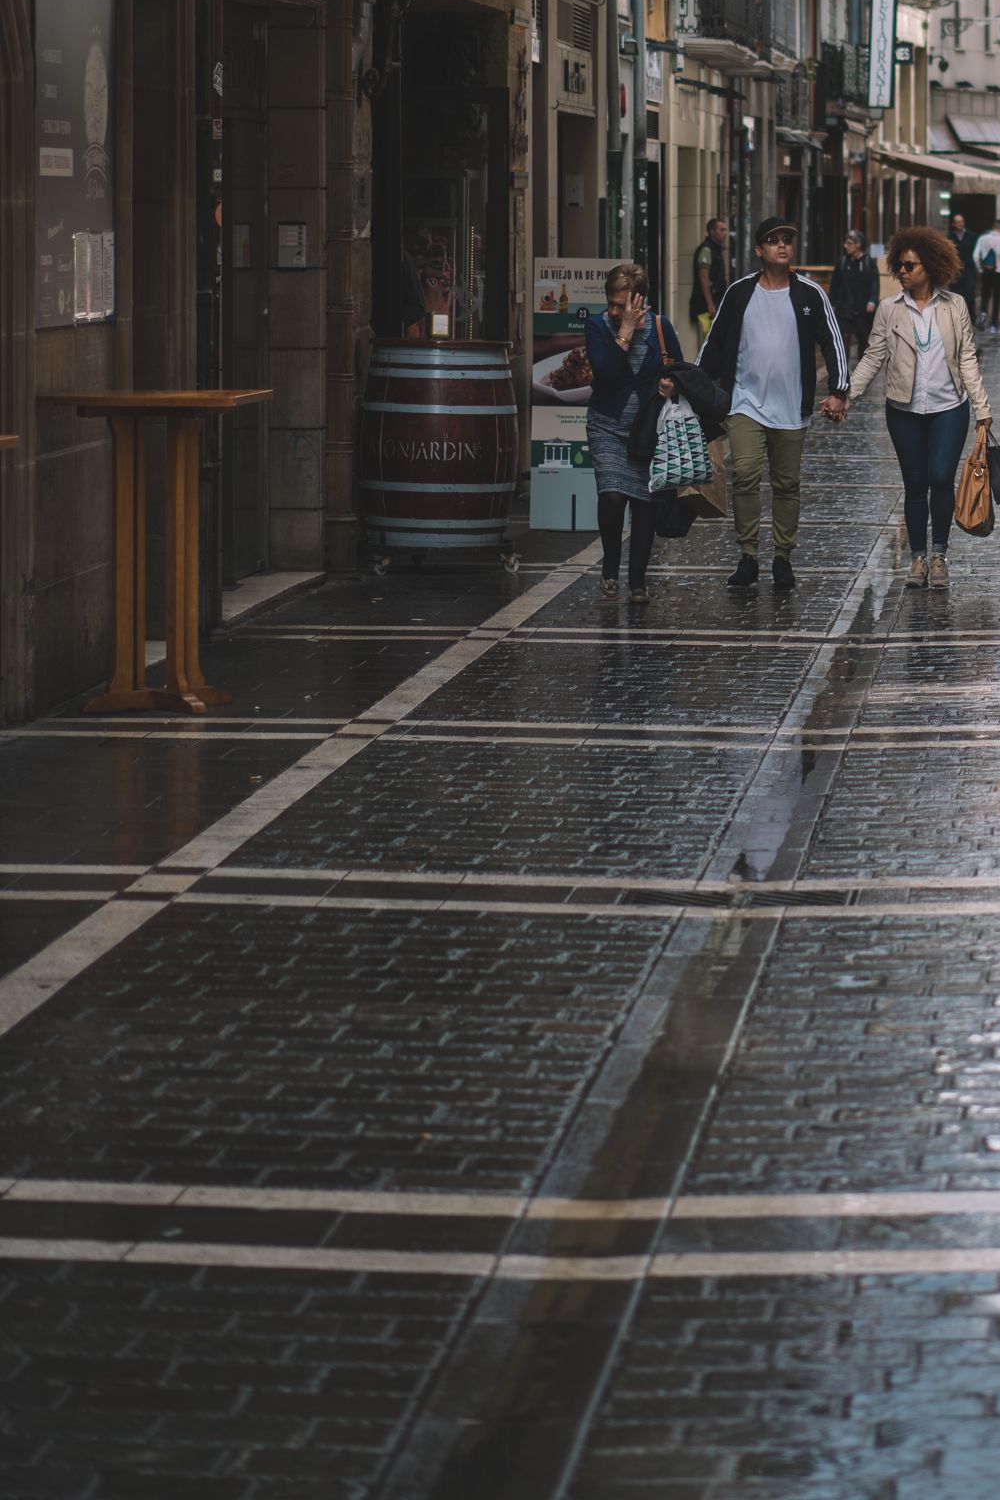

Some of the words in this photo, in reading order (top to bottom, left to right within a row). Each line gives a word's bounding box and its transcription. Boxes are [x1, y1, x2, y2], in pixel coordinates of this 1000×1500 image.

[540, 269, 549, 280] LO
[551, 269, 572, 280] VIEJO
[574, 270, 583, 280] VA
[585, 270, 595, 280] DE
[578, 309, 588, 319] 23
[373, 431, 477, 461] ONJARDIN
